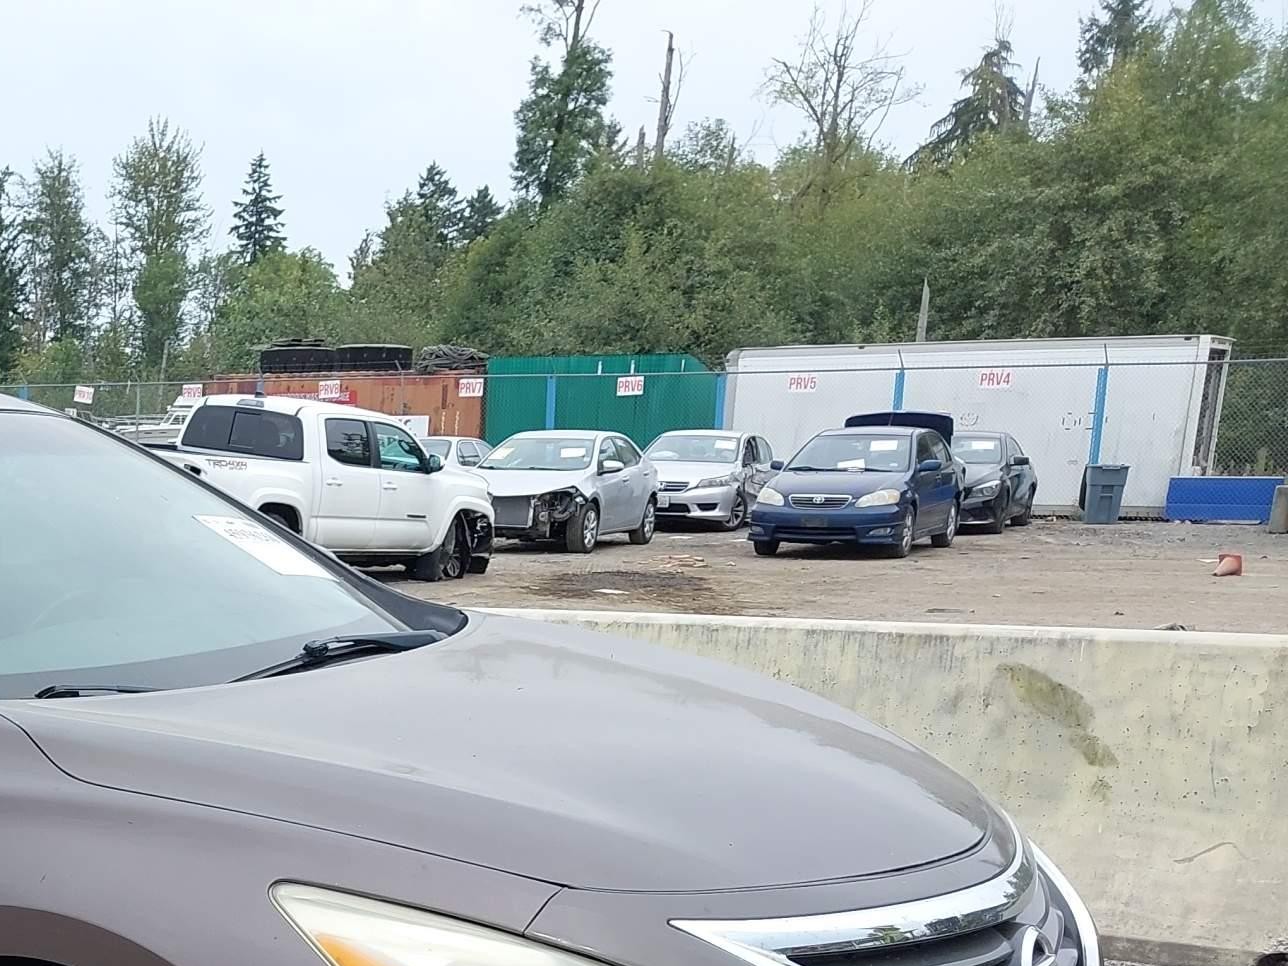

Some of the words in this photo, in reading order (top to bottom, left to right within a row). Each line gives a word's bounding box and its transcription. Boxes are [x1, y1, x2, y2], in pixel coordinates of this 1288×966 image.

[618, 379, 643, 392] PRV6
[788, 376, 817, 390] PRV5
[979, 372, 1011, 386] PRV4
[319, 383, 339, 398] PRV8
[459, 381, 482, 394] PRV7
